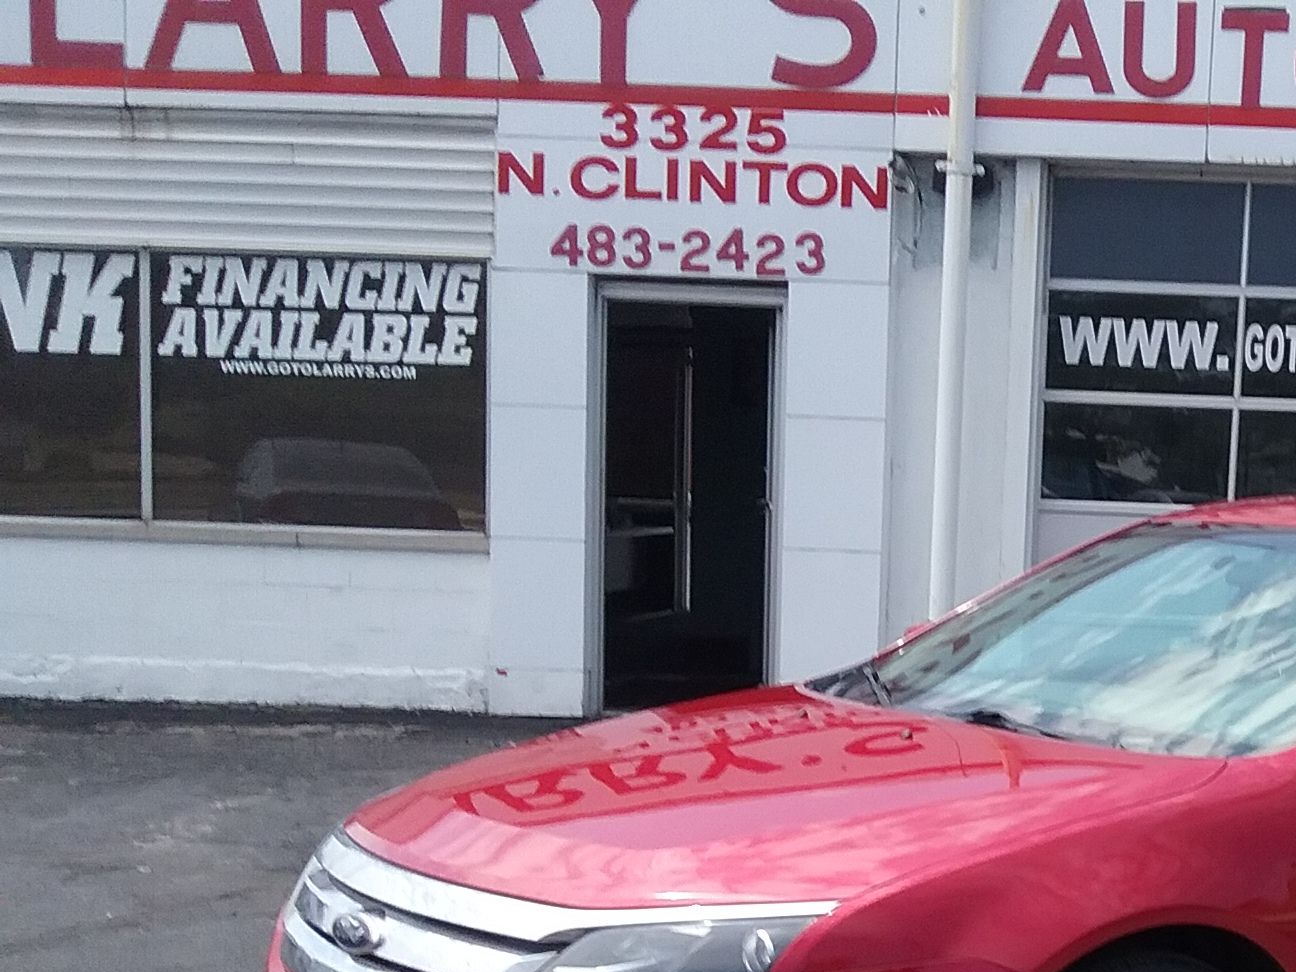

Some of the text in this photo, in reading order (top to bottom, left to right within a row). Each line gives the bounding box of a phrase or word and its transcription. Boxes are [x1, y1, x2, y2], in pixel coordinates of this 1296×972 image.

[600, 101, 788, 154] 3325
[549, 222, 826, 277] 483-2423
[161, 254, 482, 315] FINANCING
[157, 306, 478, 367] AVAILABLE
[219, 359, 417, 381] WWW.GOTOLARRYS.COM
